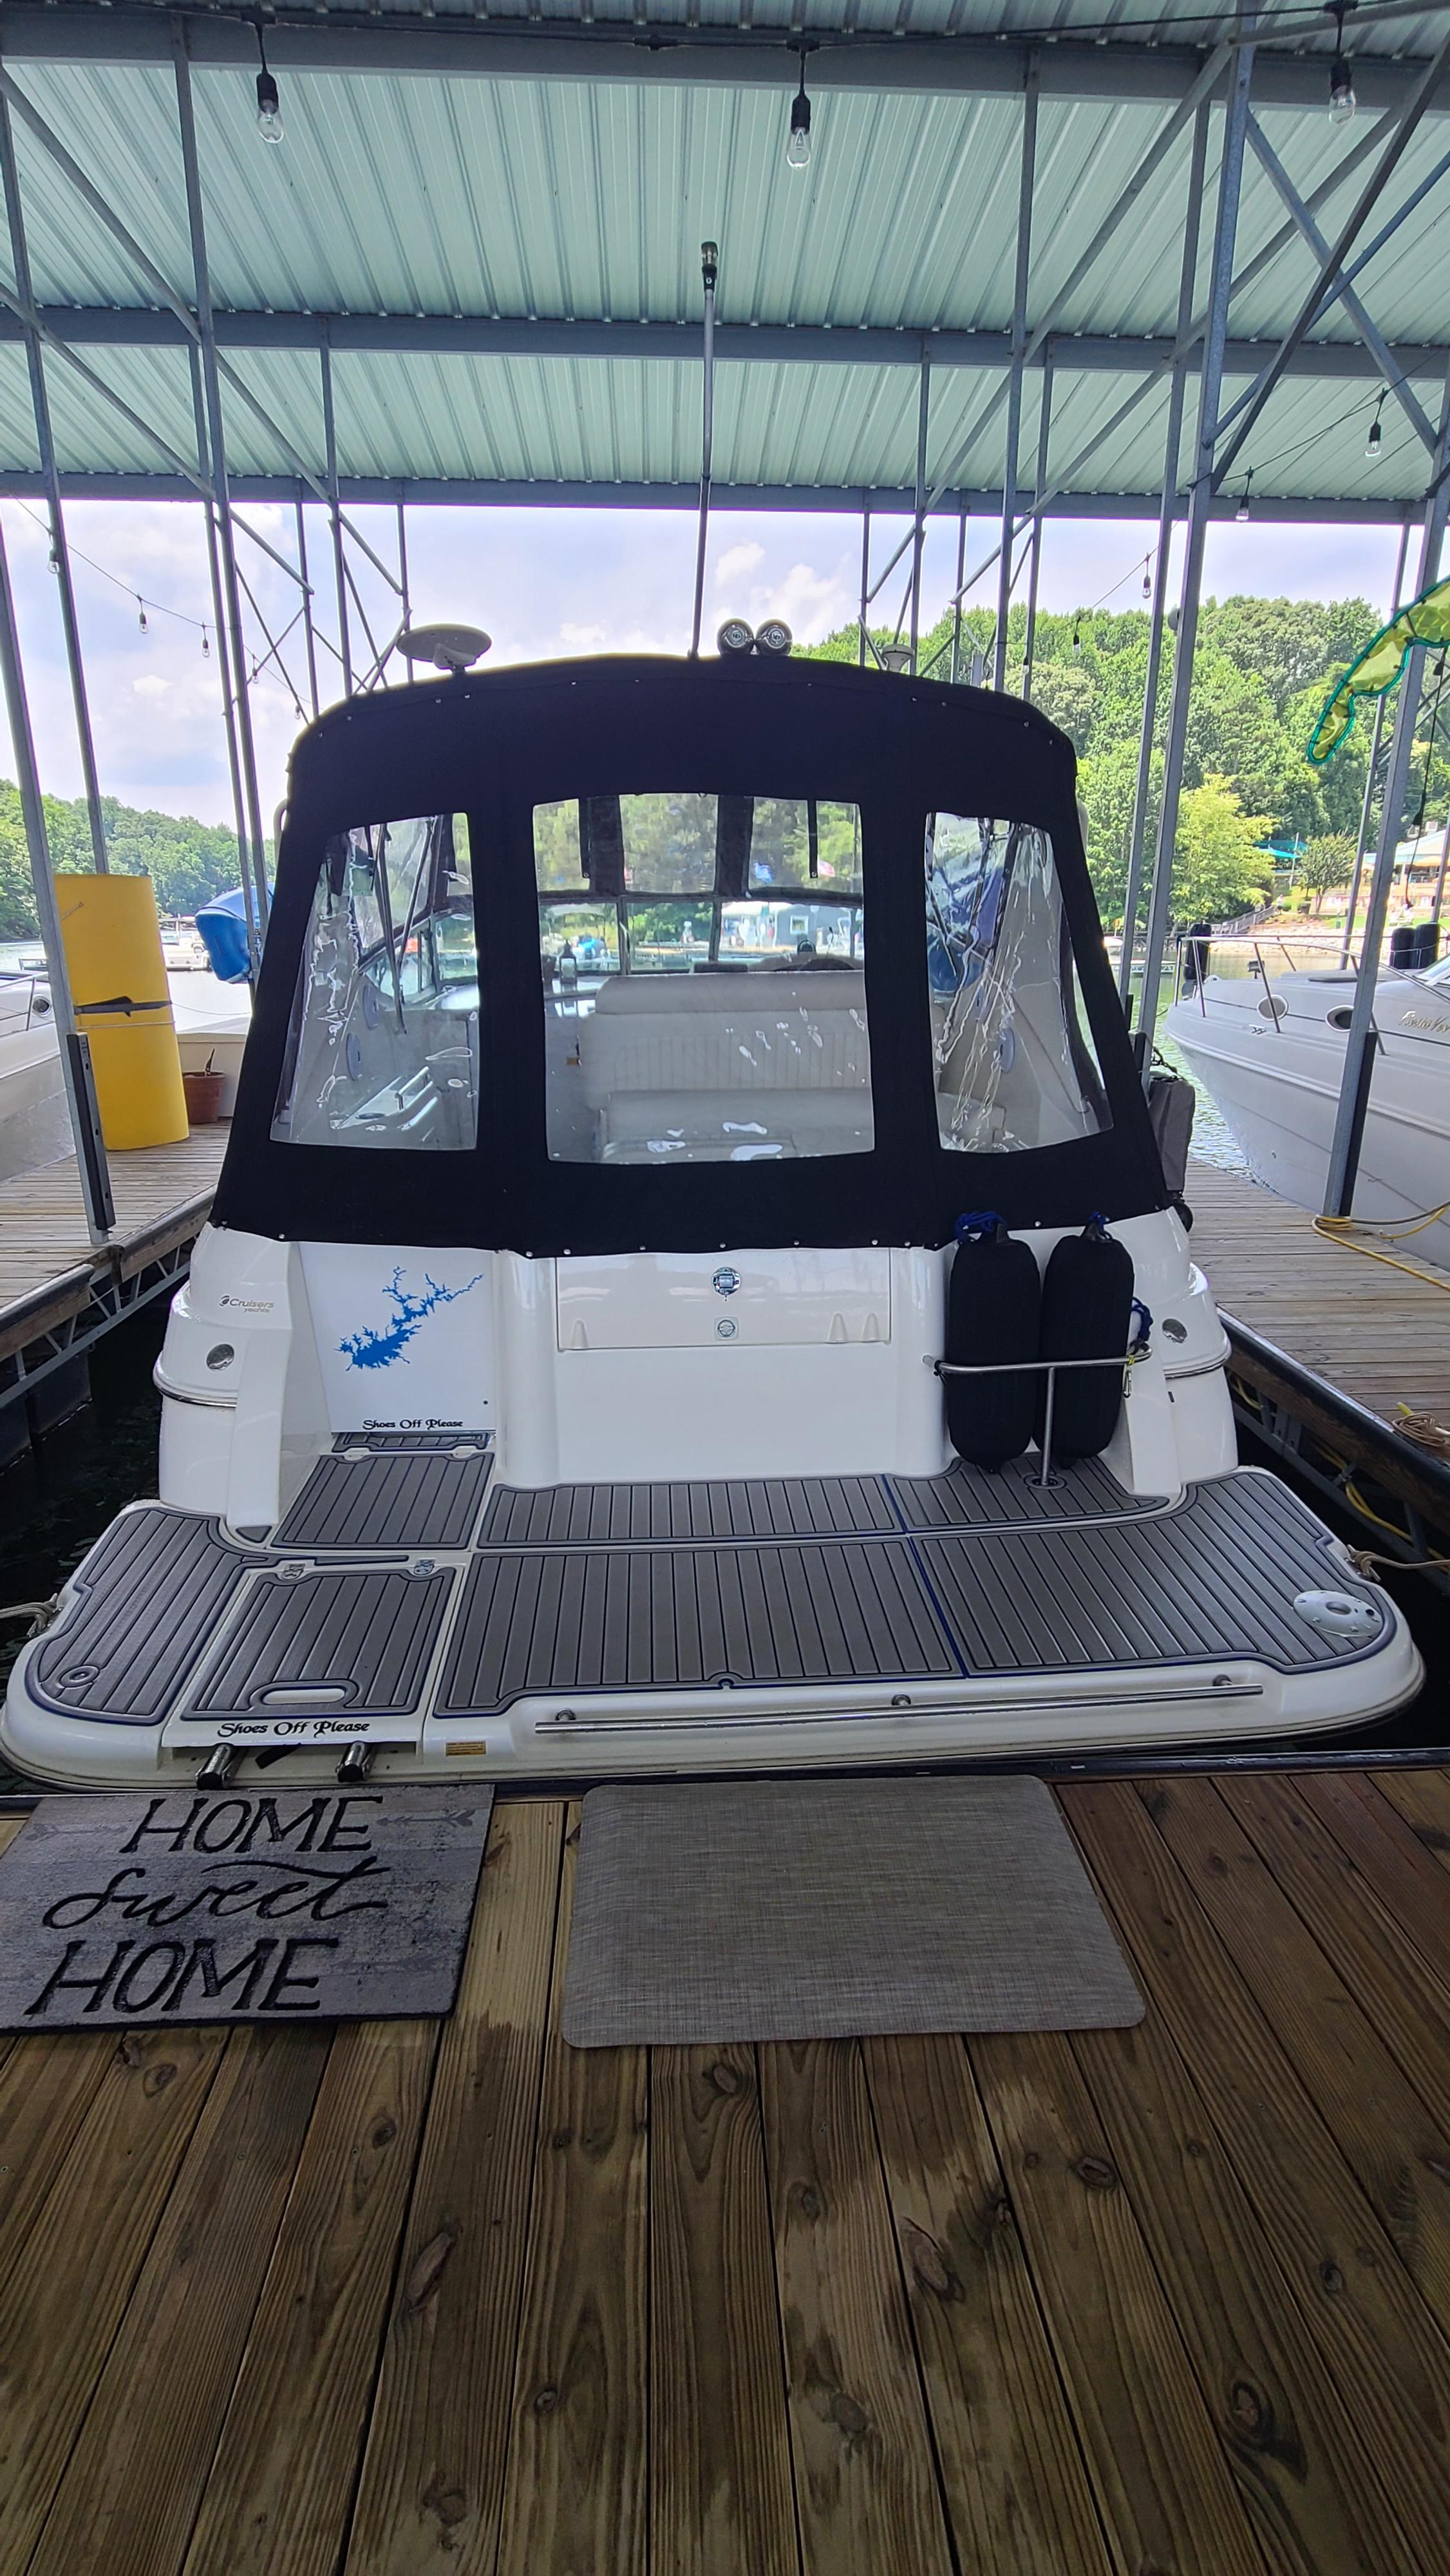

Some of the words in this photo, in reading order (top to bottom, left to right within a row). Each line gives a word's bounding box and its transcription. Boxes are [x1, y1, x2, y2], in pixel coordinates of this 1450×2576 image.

[230, 1298, 274, 1308] Cruisers
[362, 1419, 396, 1430] Shoes
[399, 1419, 422, 1429] Off
[425, 1419, 464, 1430] Please
[217, 1723, 268, 1738] Shoes
[274, 1721, 311, 1736] Off
[314, 1720, 370, 1738] Please
[118, 1795, 384, 1854] HOME
[24, 1937, 339, 2016] HOME
